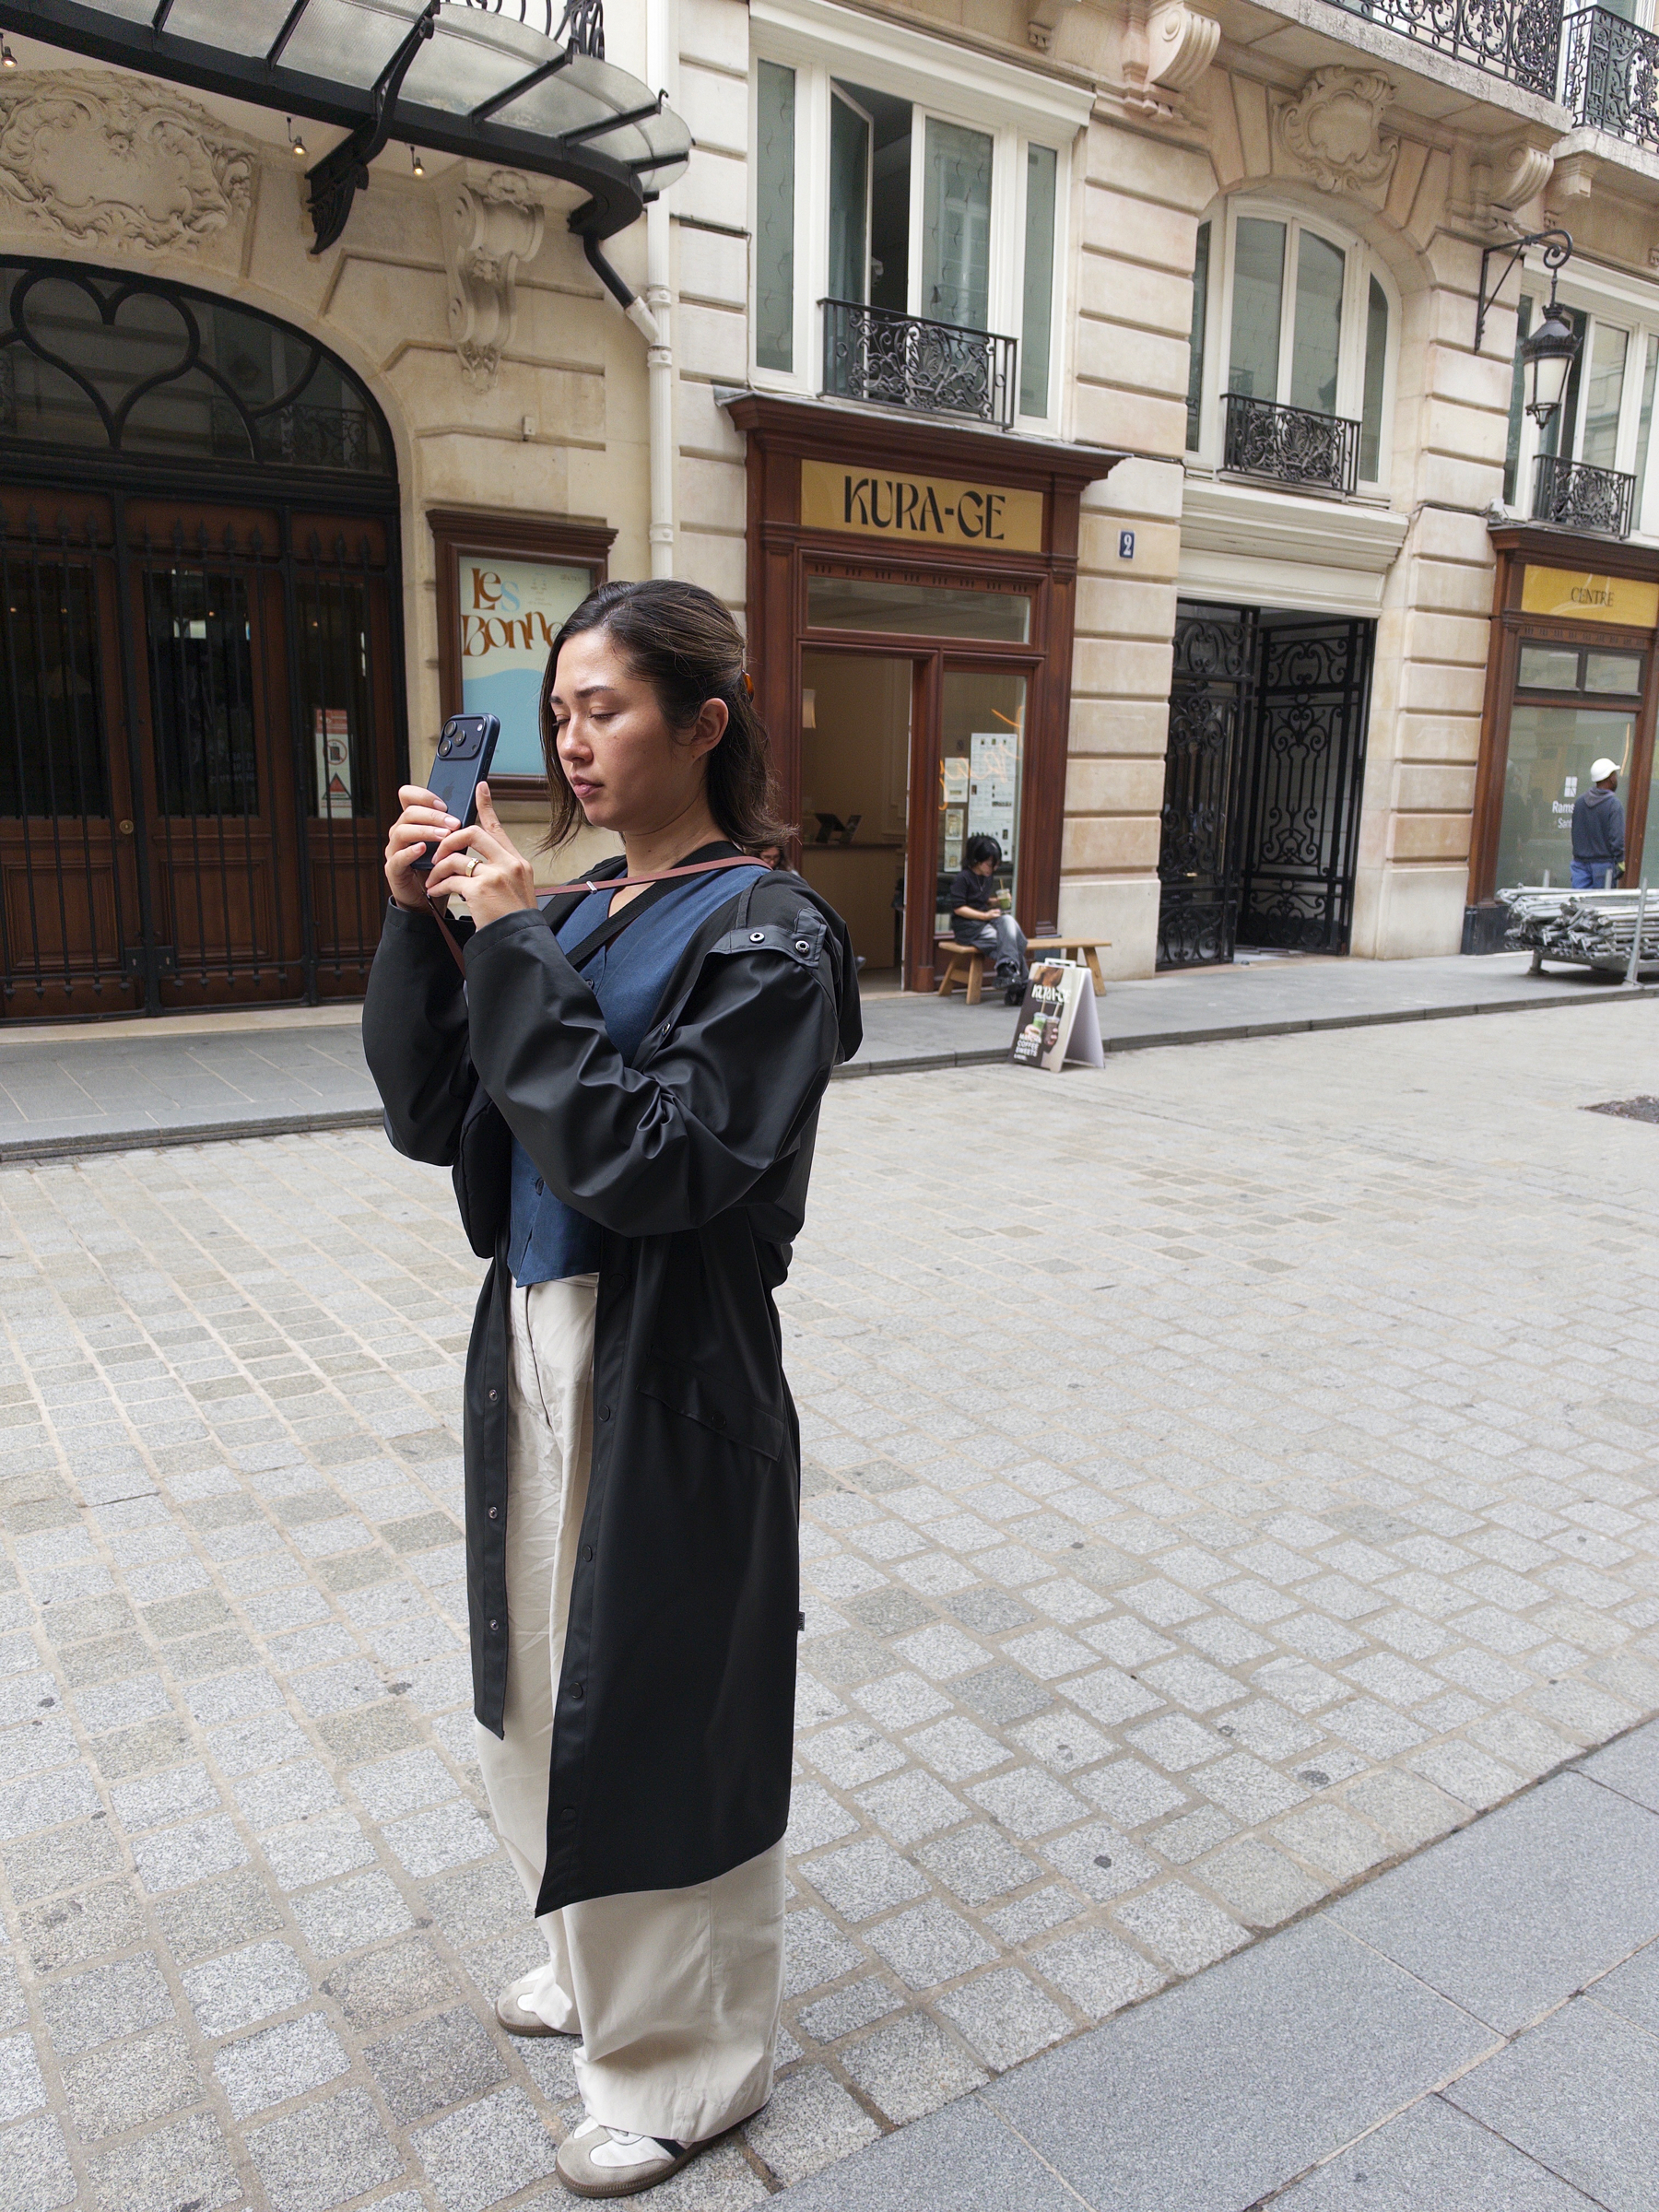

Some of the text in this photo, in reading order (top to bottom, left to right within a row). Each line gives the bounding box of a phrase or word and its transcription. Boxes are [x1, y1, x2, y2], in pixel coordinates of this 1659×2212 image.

[844, 476, 1006, 540] KURA-GE
[1123, 534, 1133, 556] 2
[471, 568, 521, 612] Les
[1571, 586, 1615, 607] CENTRE
[1031, 983, 1072, 1004] KURA-GE
[1015, 1046, 1038, 1057] SWEETS
[1017, 1040, 1040, 1051] COFFEE
